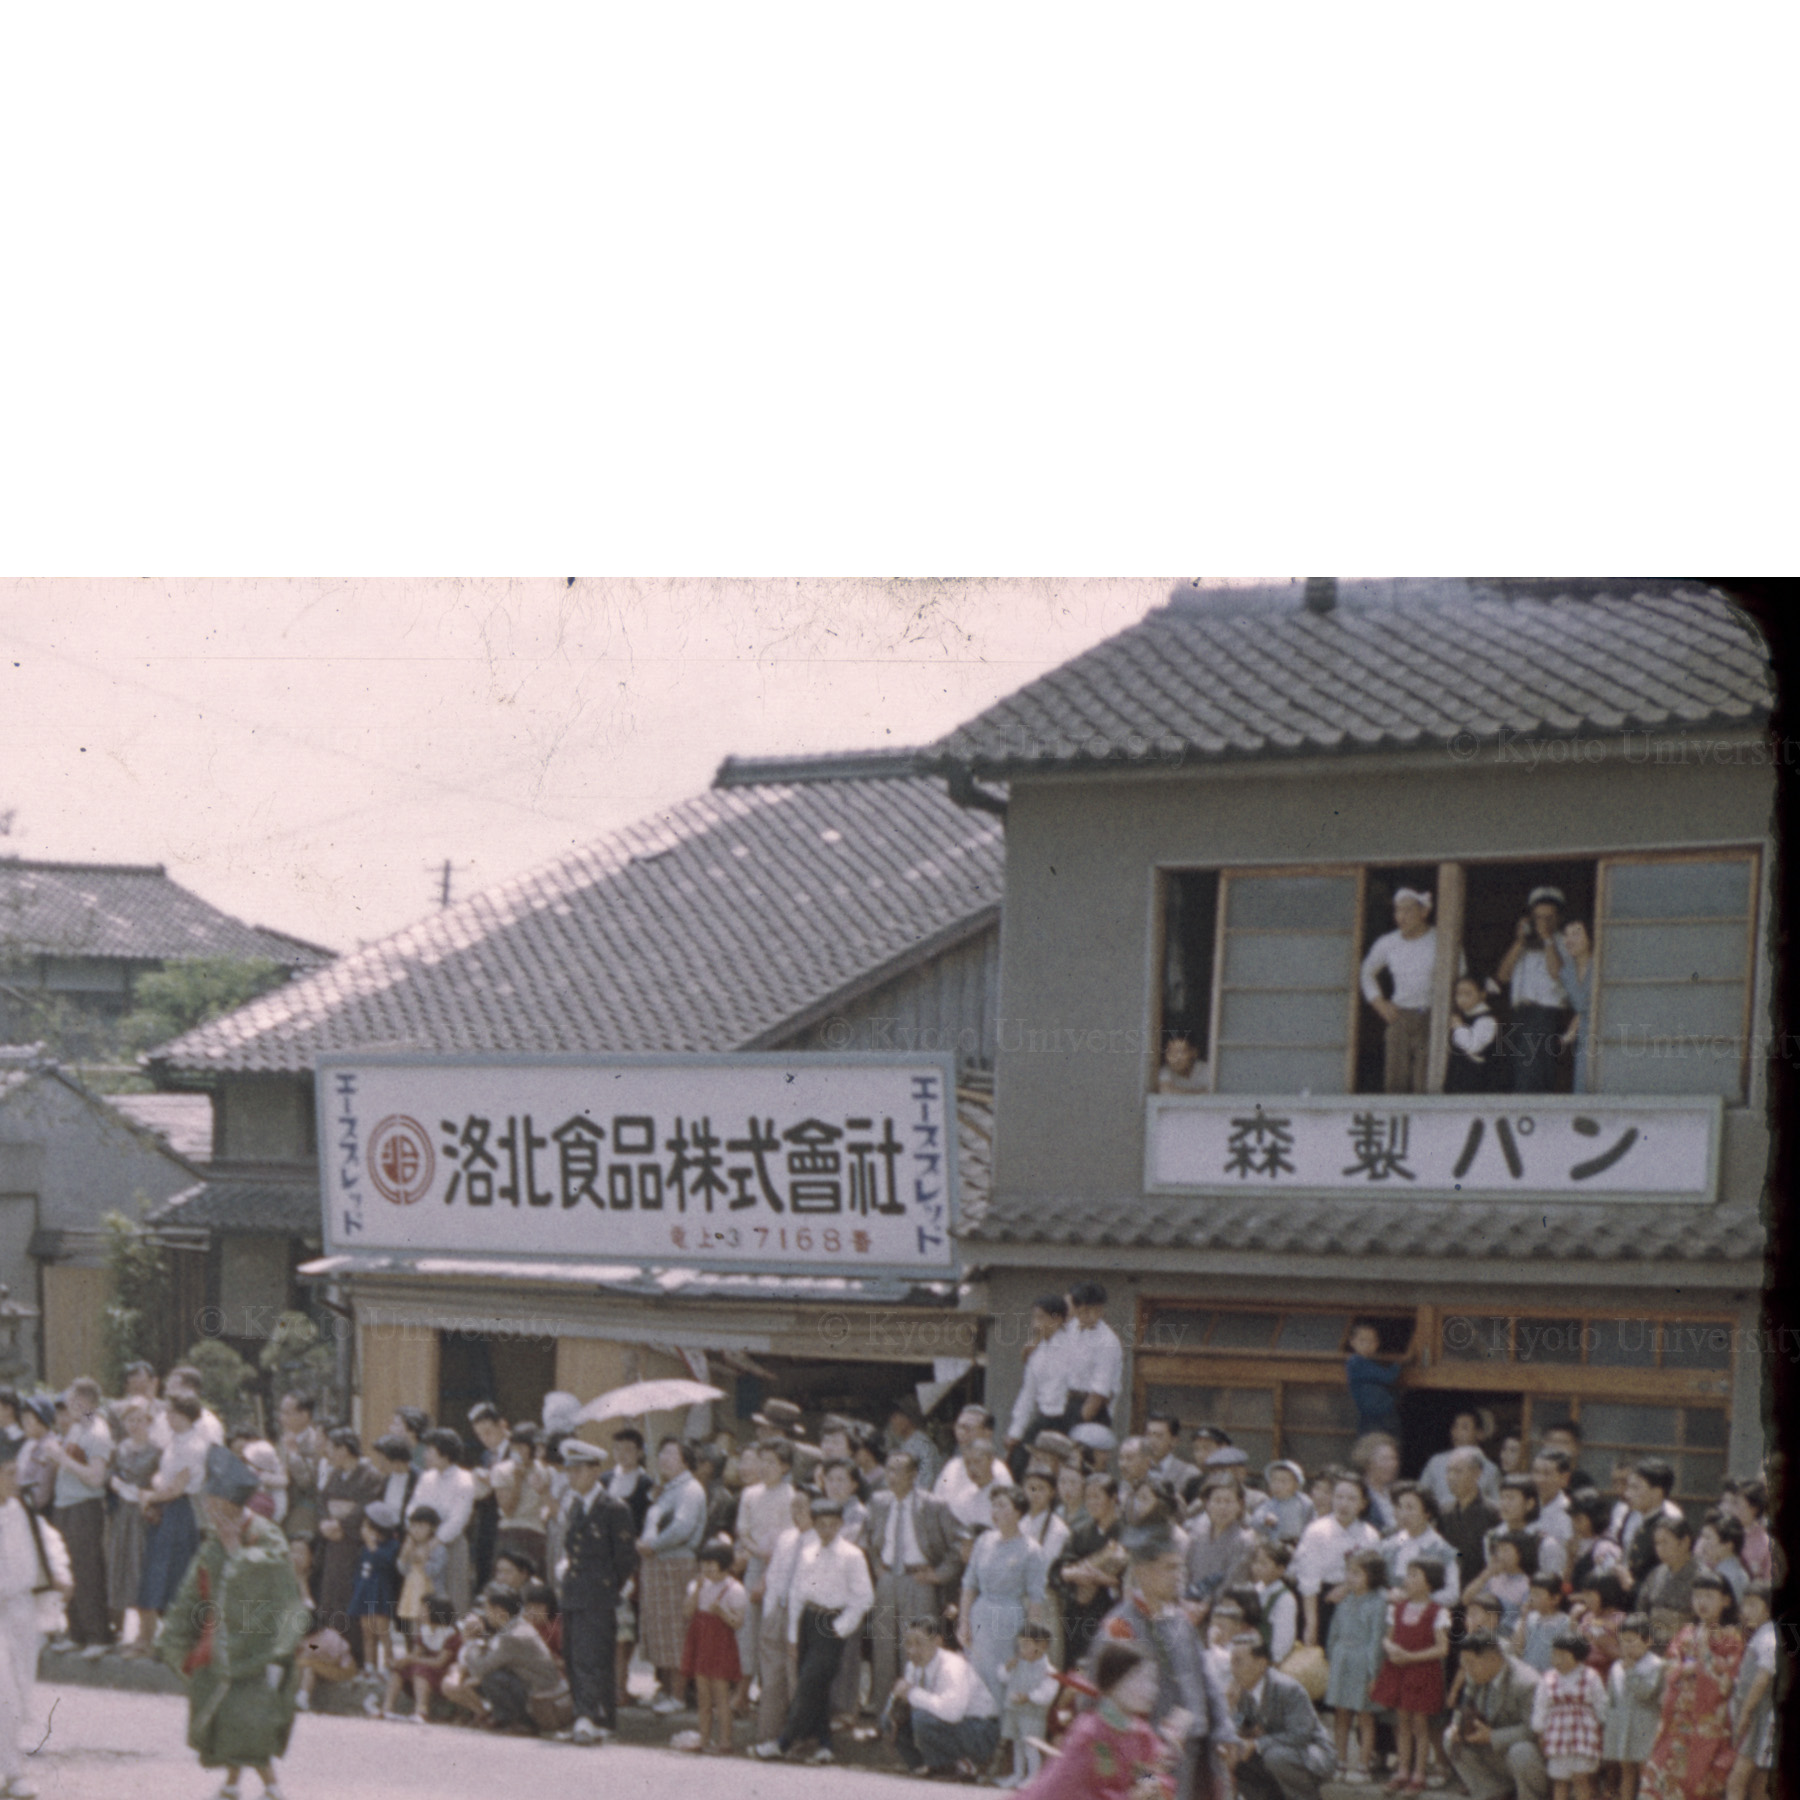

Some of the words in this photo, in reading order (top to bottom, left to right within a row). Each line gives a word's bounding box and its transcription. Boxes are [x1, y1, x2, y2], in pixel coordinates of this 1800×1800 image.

[440, 1113, 906, 1216] 洛北食品株式會社
[1224, 1111, 1640, 1180] 森製パン
